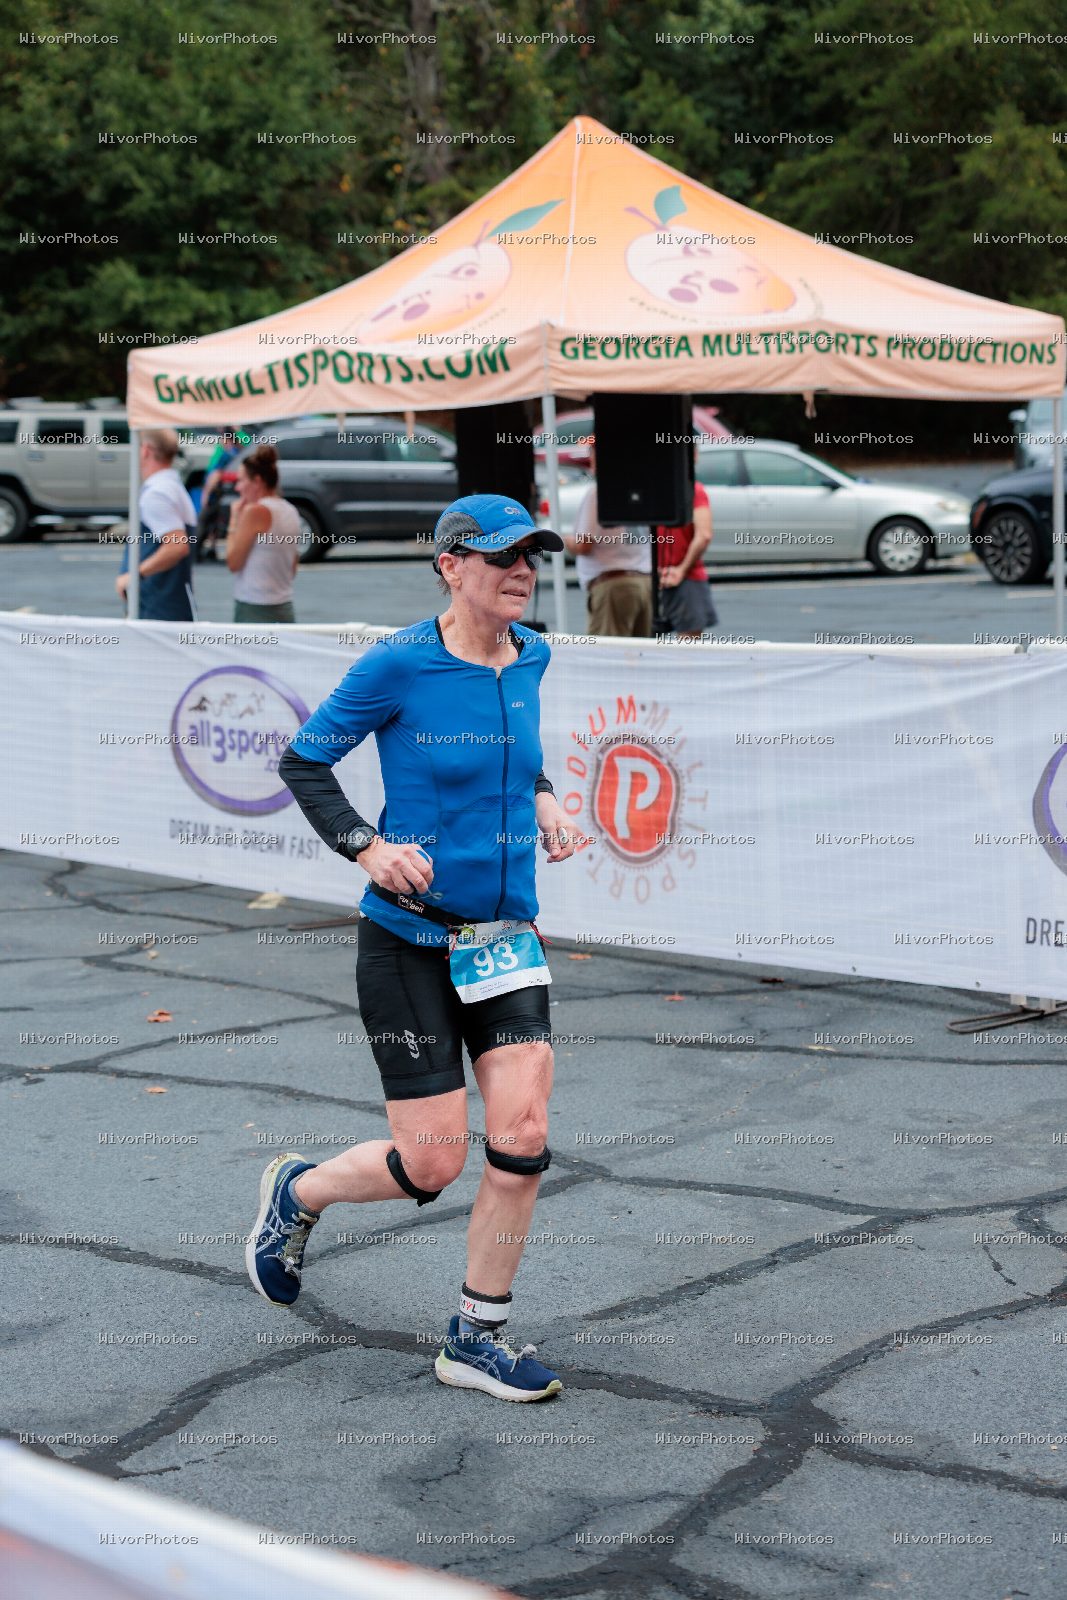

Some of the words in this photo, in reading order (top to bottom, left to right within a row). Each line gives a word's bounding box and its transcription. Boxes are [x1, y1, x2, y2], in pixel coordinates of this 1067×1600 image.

[560, 335, 694, 361] GEORGIA
[701, 332, 878, 360] MULTISPORTS
[886, 337, 1057, 366] PRODUCTIONS
[1025, 917, 1067, 947] DRE
[473, 942, 519, 977] 93
